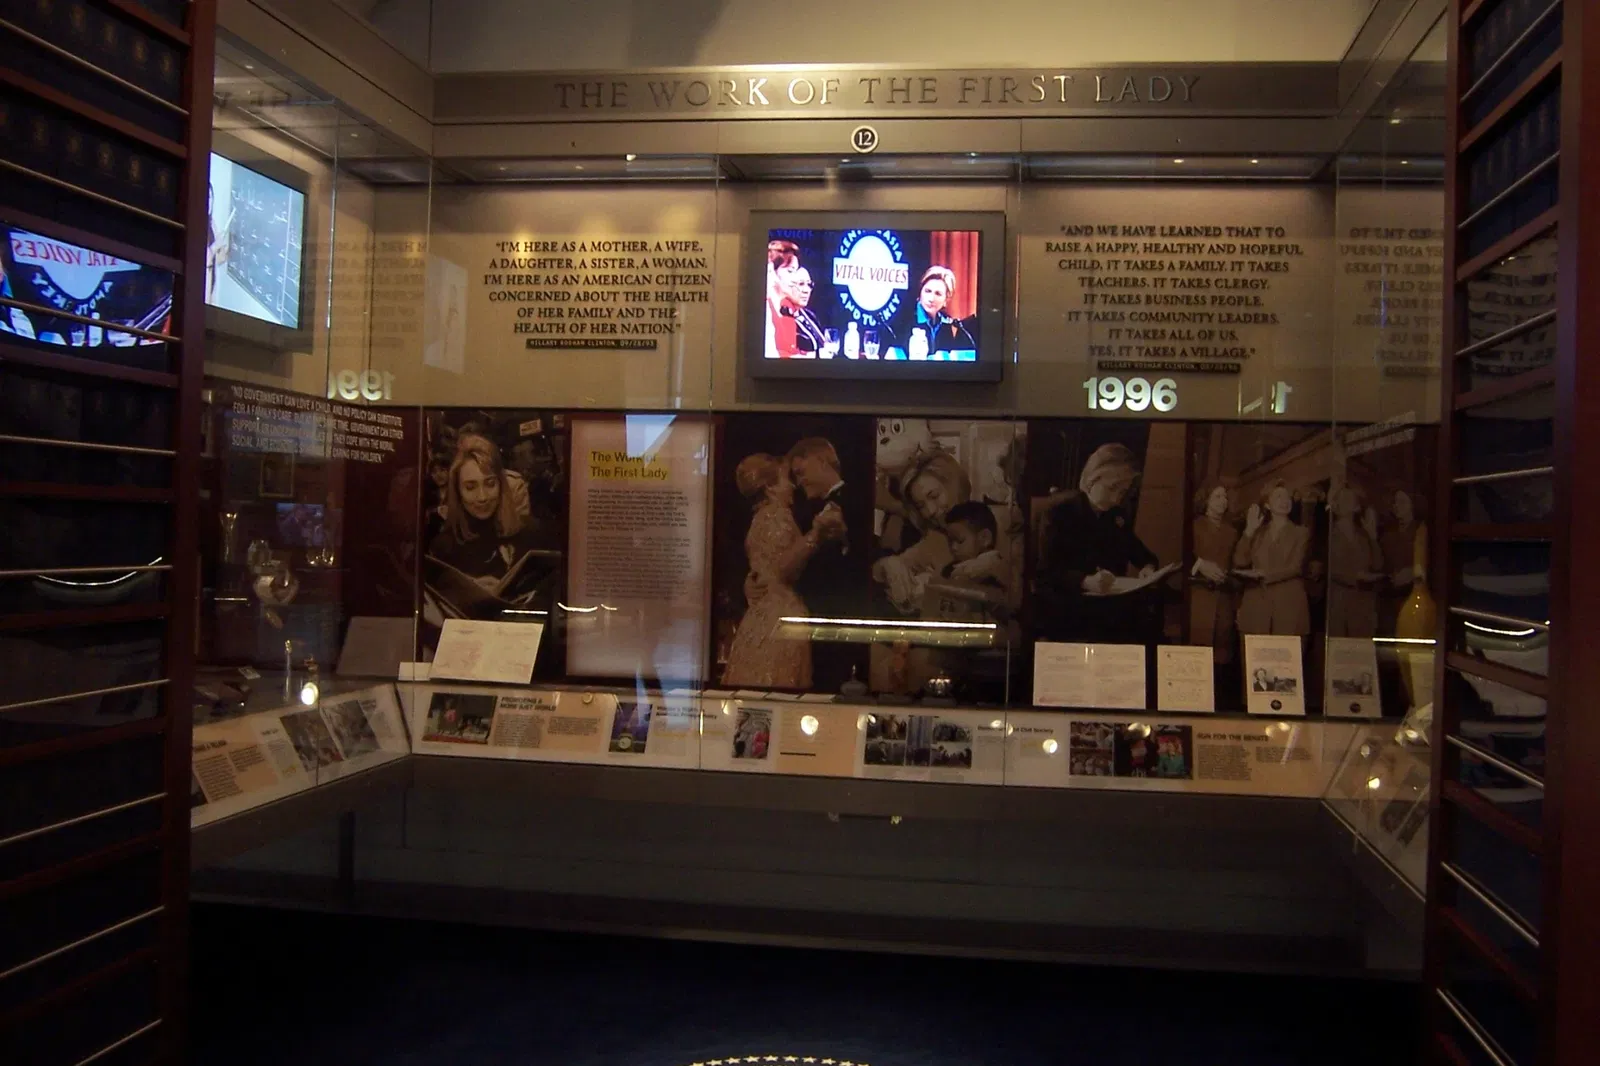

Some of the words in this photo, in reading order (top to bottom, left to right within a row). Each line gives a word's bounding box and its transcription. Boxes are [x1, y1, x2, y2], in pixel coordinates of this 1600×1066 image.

[555, 82, 628, 109] THE
[648, 78, 770, 107] WORK
[787, 77, 840, 105] OF
[859, 77, 937, 104] THE
[958, 75, 1074, 104] FIRST
[1095, 75, 1199, 104] LADY
[857, 131, 873, 146] 12
[1097, 225, 1118, 236] WE
[1123, 225, 1156, 236] HAVE
[1160, 226, 1221, 237] LEARNED
[1226, 227, 1261, 238] THAT
[1265, 227, 1285, 238] TO
[524, 242, 558, 252] HERE
[562, 242, 576, 252] AS
[579, 242, 587, 252] A
[591, 241, 651, 253] MOTHER,
[655, 241, 662, 252] A
[1045, 242, 1082, 253] RAISE
[1084, 243, 1092, 253] A
[1096, 243, 1140, 255] HAPPY,
[1144, 243, 1205, 254] HEALTHY
[1207, 244, 1237, 255] AND
[1240, 244, 1304, 255] HOPEFUL
[489, 258, 497, 269] A
[501, 258, 577, 271] DAUGHTER,
[579, 258, 587, 269] A
[591, 258, 639, 271] SISTER,
[641, 258, 649, 269] A
[653, 258, 708, 269] WOMAN.
[1107, 260, 1119, 270] IT
[1123, 260, 1164, 271] TAKES
[1168, 260, 1176, 271] A
[1230, 261, 1244, 272] IT
[1248, 261, 1289, 272] TAKES
[484, 275, 502, 286] I'M
[506, 275, 541, 286] HERE
[544, 275, 558, 286] AS
[562, 275, 580, 286] AN
[583, 275, 652, 286] AMERICAN
[655, 275, 712, 286] CITIZEN
[835, 264, 865, 281] VITAL
[870, 267, 909, 284] VOICES
[1153, 278, 1168, 288] IT
[1171, 278, 1211, 289] TAKES
[489, 291, 571, 303] CONCERNED
[574, 291, 620, 302] ABOUT
[623, 291, 651, 302] THE
[655, 291, 709, 303] HEALTH
[1083, 294, 1098, 305] IT
[1101, 294, 1141, 305] TAKES
[1145, 295, 1207, 306] BUSINESS
[517, 308, 534, 318] OF
[538, 308, 564, 318] HER
[568, 308, 614, 318] FAMILY
[616, 308, 645, 318] AND
[648, 308, 677, 318] THE
[840, 293, 861, 320] AND
[1067, 311, 1082, 322] IT
[1085, 312, 1125, 323] TAKES
[1129, 312, 1215, 324] COMMUNITY
[514, 323, 566, 334] HEALTH
[569, 323, 587, 334] OF
[590, 323, 617, 334] HER
[1108, 329, 1122, 340] IT
[1125, 329, 1166, 340] TAKES
[1169, 329, 1194, 340] ALL
[1198, 329, 1215, 341] OF
[1119, 346, 1131, 356] IT
[1135, 346, 1176, 357] TAKES
[1180, 347, 1188, 357] A
[1083, 376, 1178, 412] 1996
[233, 401, 245, 414] FOR
[244, 388, 283, 404] GOVERNMENT
[284, 396, 295, 407] CAN
[297, 398, 310, 410] LOVE
[351, 408, 367, 419] POLICY
[591, 451, 611, 462] The
[591, 466, 611, 477] The
[614, 466, 638, 478] First
[641, 467, 667, 480] Lady
